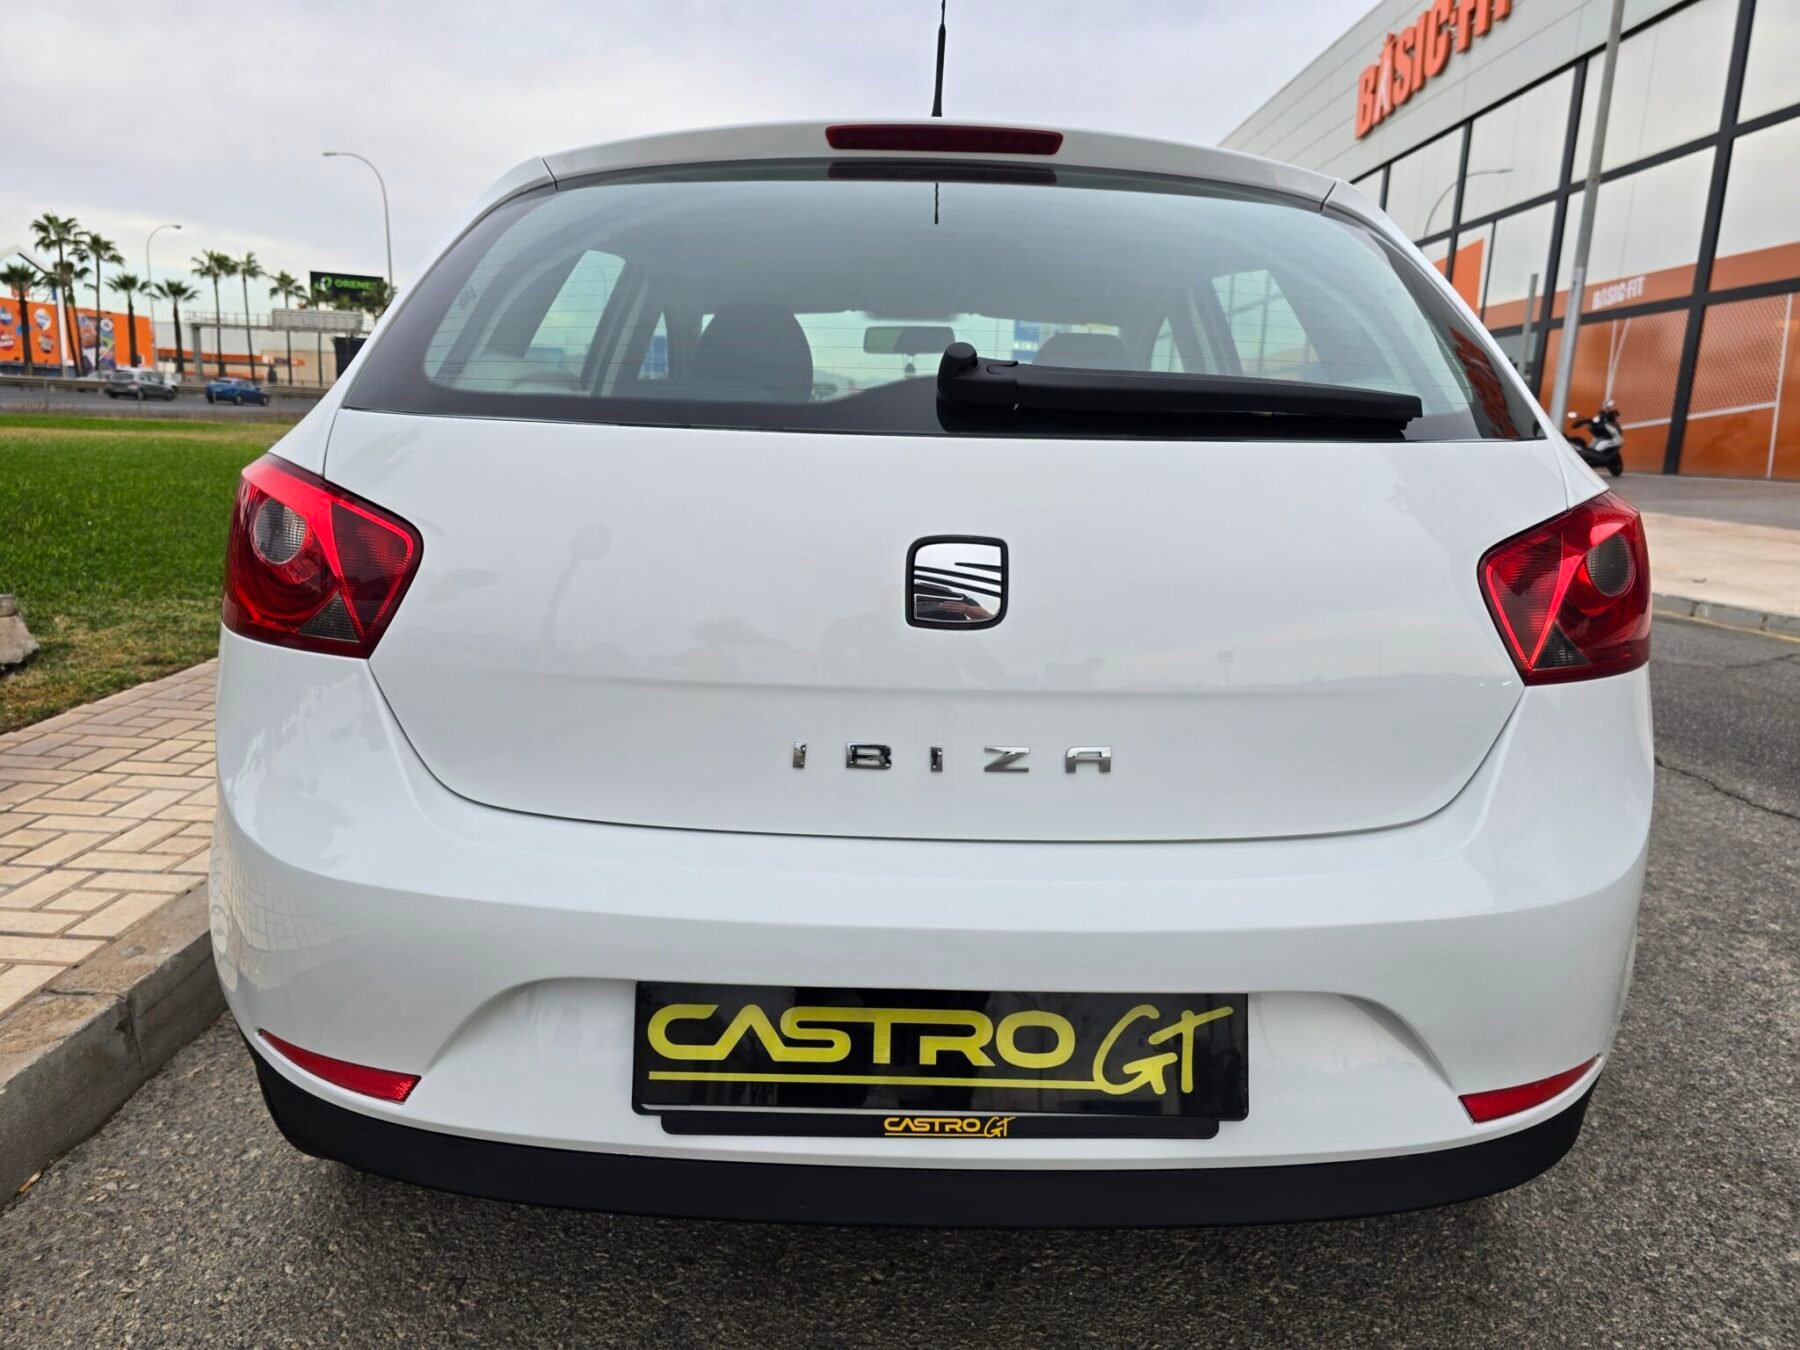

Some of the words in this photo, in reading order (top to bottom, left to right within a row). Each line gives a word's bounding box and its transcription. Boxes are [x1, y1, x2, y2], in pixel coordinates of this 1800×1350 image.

[1355, 0, 1512, 140] BASIC-F
[792, 741, 1112, 774] IBIZA
[647, 1003, 1076, 1069] CASTRO
[1092, 1004, 1234, 1095] GT
[883, 1117, 981, 1132] CASTRO
[983, 1116, 1016, 1138] GT
